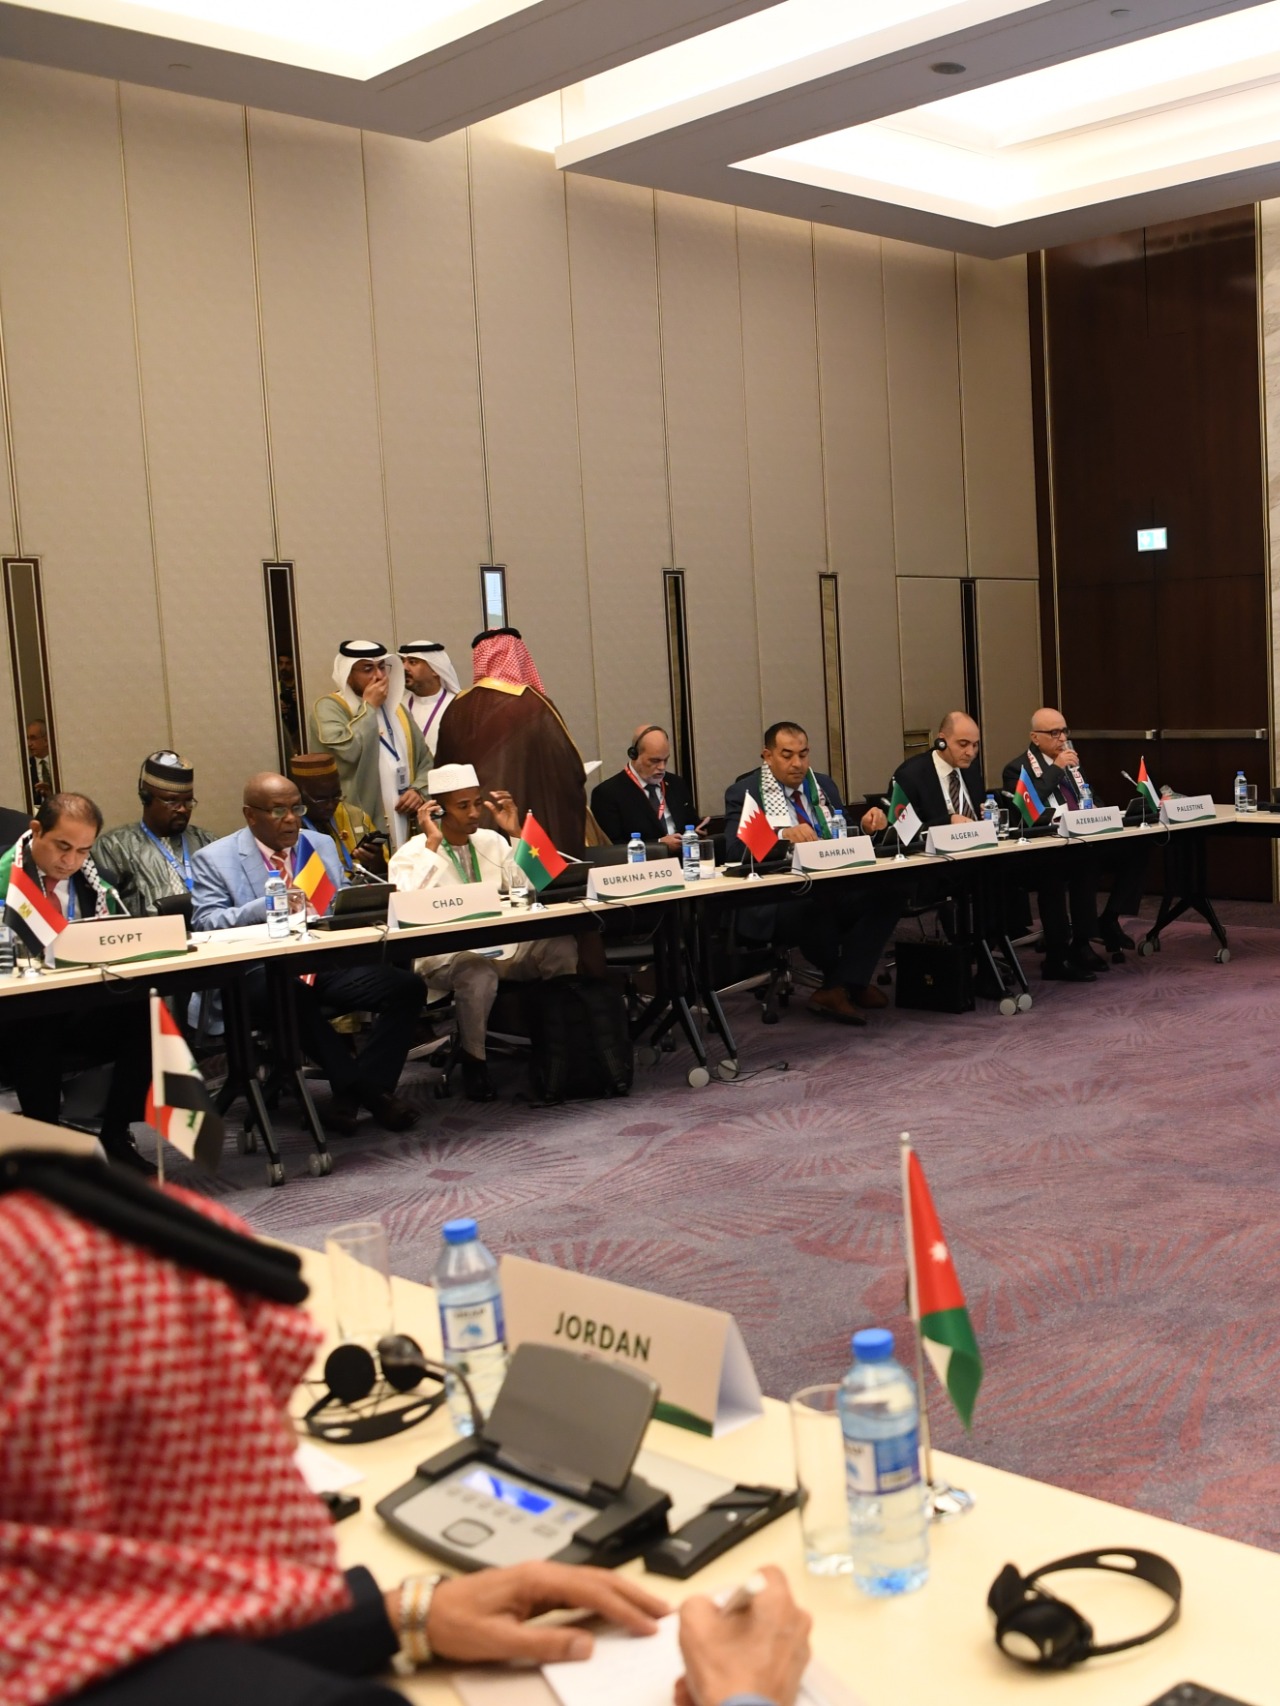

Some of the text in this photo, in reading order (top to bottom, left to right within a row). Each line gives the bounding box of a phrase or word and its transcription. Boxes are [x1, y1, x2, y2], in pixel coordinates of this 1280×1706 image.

[1176, 803, 1204, 813] PALESTINE
[1075, 815, 1112, 825] AZERBAIJAN
[950, 830, 980, 841] ALGERIA
[818, 847, 856, 858] BAHRAIN
[602, 869, 673, 886] BURKINA FASO
[432, 897, 464, 909] CHAD
[99, 932, 143, 946] EGYPT
[554, 1311, 652, 1361] JORDAN
